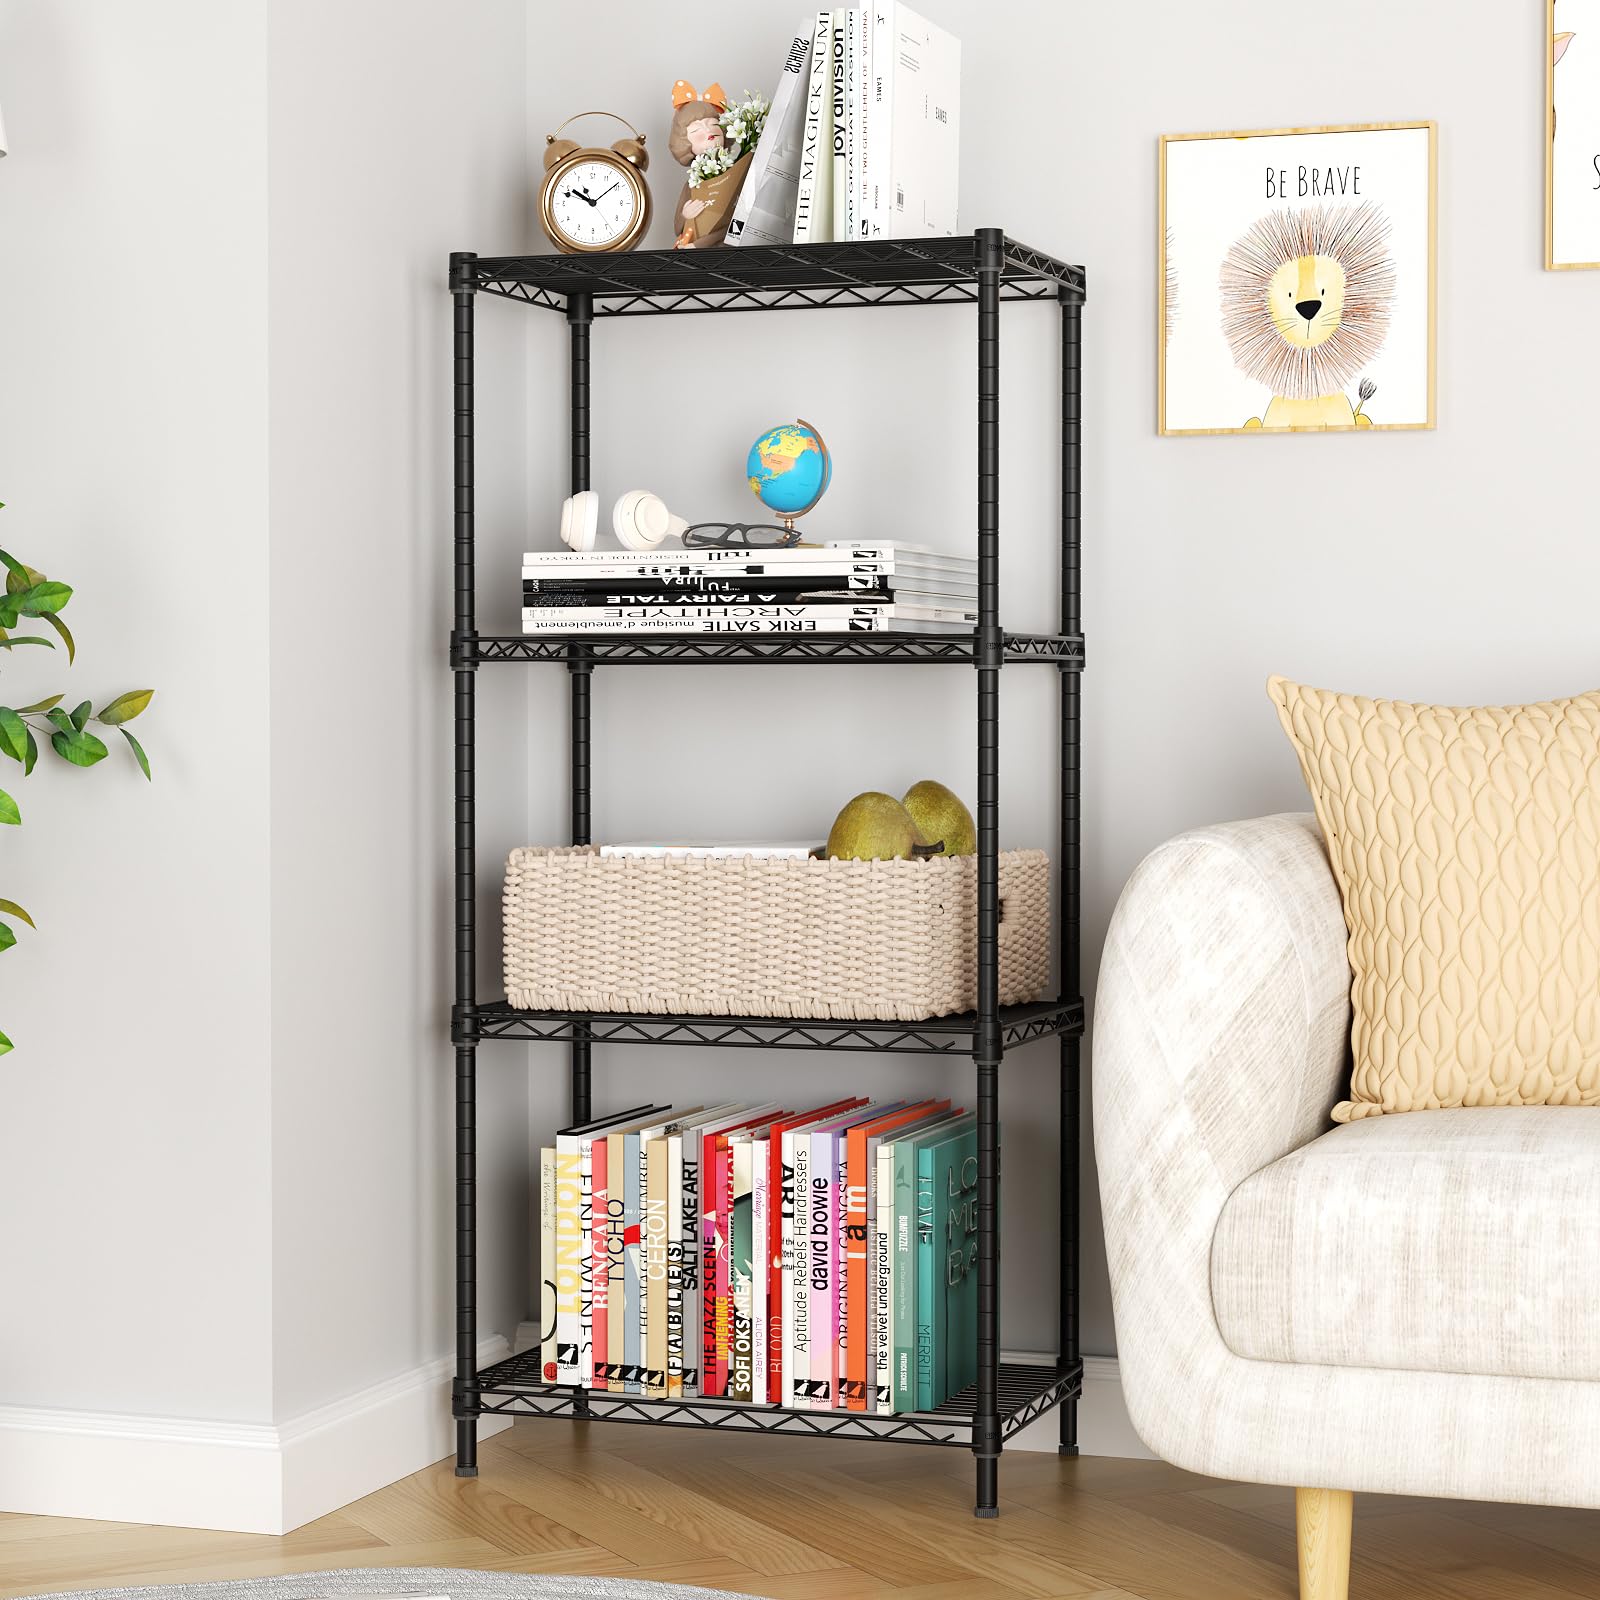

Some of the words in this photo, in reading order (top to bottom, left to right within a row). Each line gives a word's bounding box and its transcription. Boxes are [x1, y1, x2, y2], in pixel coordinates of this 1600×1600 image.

[862, 61, 868, 77] OF
[802, 82, 822, 180] MAGICK
[833, 125, 846, 158] joy
[1266, 167, 1288, 199] BE
[1297, 166, 1362, 197] BRAVE
[797, 189, 811, 235] THE
[603, 607, 806, 618] ARCHITYPE
[606, 595, 670, 603] TALE
[675, 594, 750, 603] FAIRY
[757, 594, 777, 602] A
[640, 620, 695, 628] musique
[702, 620, 760, 631] SATIE
[767, 620, 816, 631] ERIK
[682, 1158, 698, 1191] ART
[794, 1150, 807, 1236] Hairdressers
[948, 1157, 978, 1197] LO
[754, 1178, 767, 1219] Marriage
[810, 1177, 829, 1235] bowie
[556, 1153, 582, 1313] LONDON
[647, 1199, 666, 1281] CERON
[682, 1197, 698, 1243] LAKE
[899, 1215, 908, 1252] BUMFUZZLE
[593, 1188, 608, 1309] BENGALA
[608, 1199, 624, 1286] TYCHO
[682, 1246, 698, 1290] SALT
[704, 1236, 716, 1291] SCENE
[794, 1241, 807, 1286] Rebels
[810, 1240, 829, 1290] david
[877, 1233, 890, 1309] underground
[704, 1293, 716, 1340] JAZZ
[735, 1273, 751, 1352] OKSANEN
[755, 1317, 763, 1348] ALICIA
[793, 1290, 811, 1353] Aptitude
[877, 1312, 888, 1349] velvet
[704, 1344, 716, 1376] THE
[735, 1357, 751, 1392] SOFI
[755, 1351, 763, 1380] AIREY
[877, 1351, 888, 1370] the
[918, 1324, 931, 1388] MERRITT
